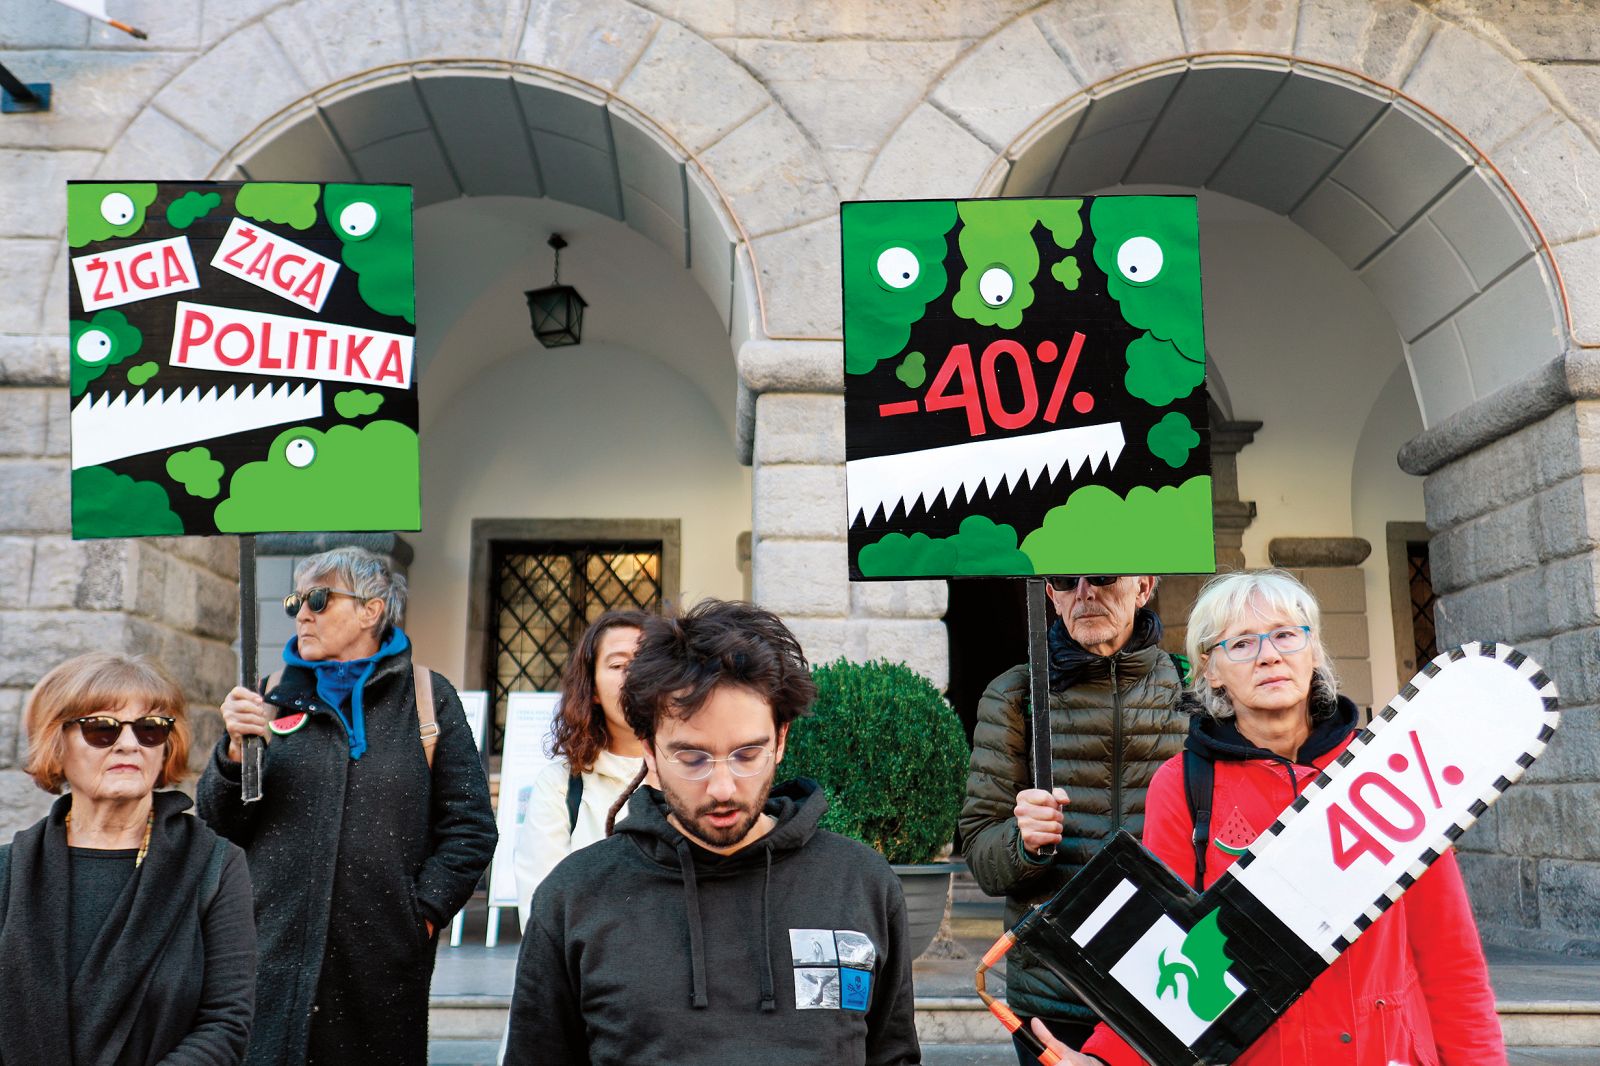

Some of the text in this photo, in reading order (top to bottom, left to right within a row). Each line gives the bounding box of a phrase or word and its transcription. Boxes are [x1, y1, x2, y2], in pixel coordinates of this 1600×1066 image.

[86, 245, 190, 302] ŽIGA
[223, 227, 326, 306] ŽAGA
[177, 310, 405, 385] POLITIKA
[1326, 730, 1465, 871] 40%
